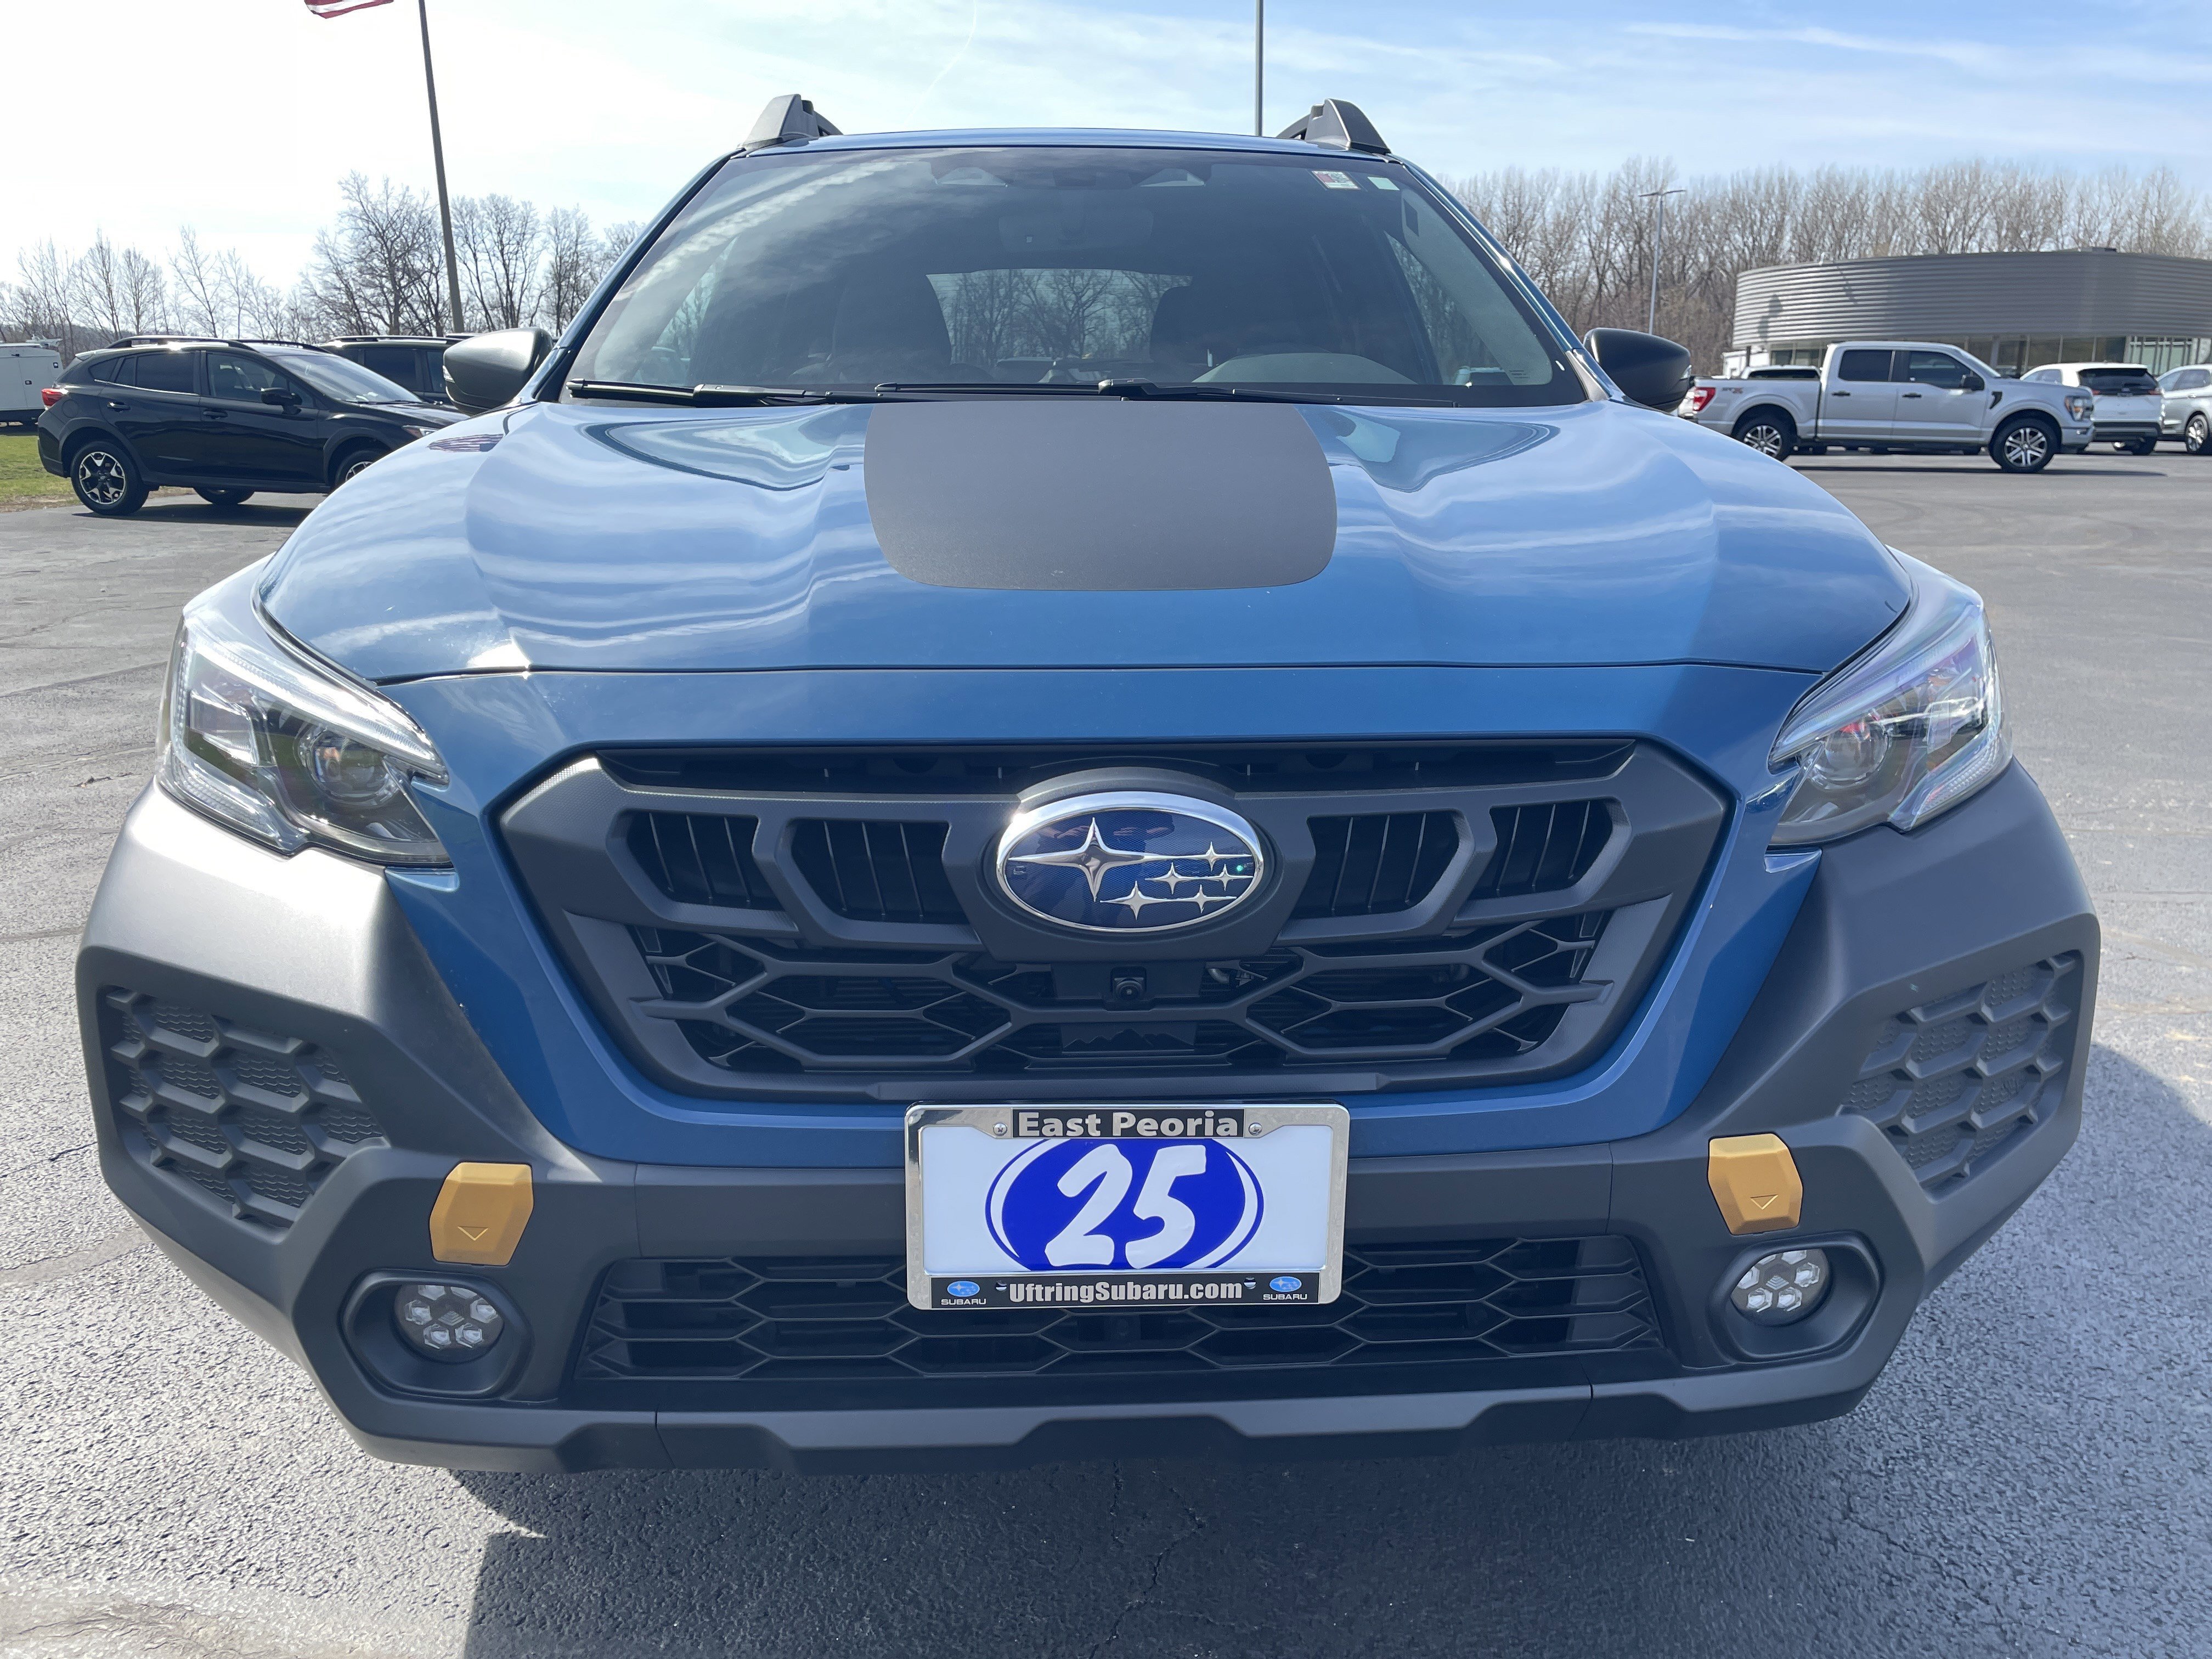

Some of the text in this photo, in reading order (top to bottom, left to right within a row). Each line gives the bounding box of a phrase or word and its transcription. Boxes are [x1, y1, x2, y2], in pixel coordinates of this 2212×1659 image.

[1019, 1110, 1238, 1137] East Peoria
[1045, 1144, 1206, 1269] 25
[1009, 1282, 1242, 1303] UftringSubaru.com
